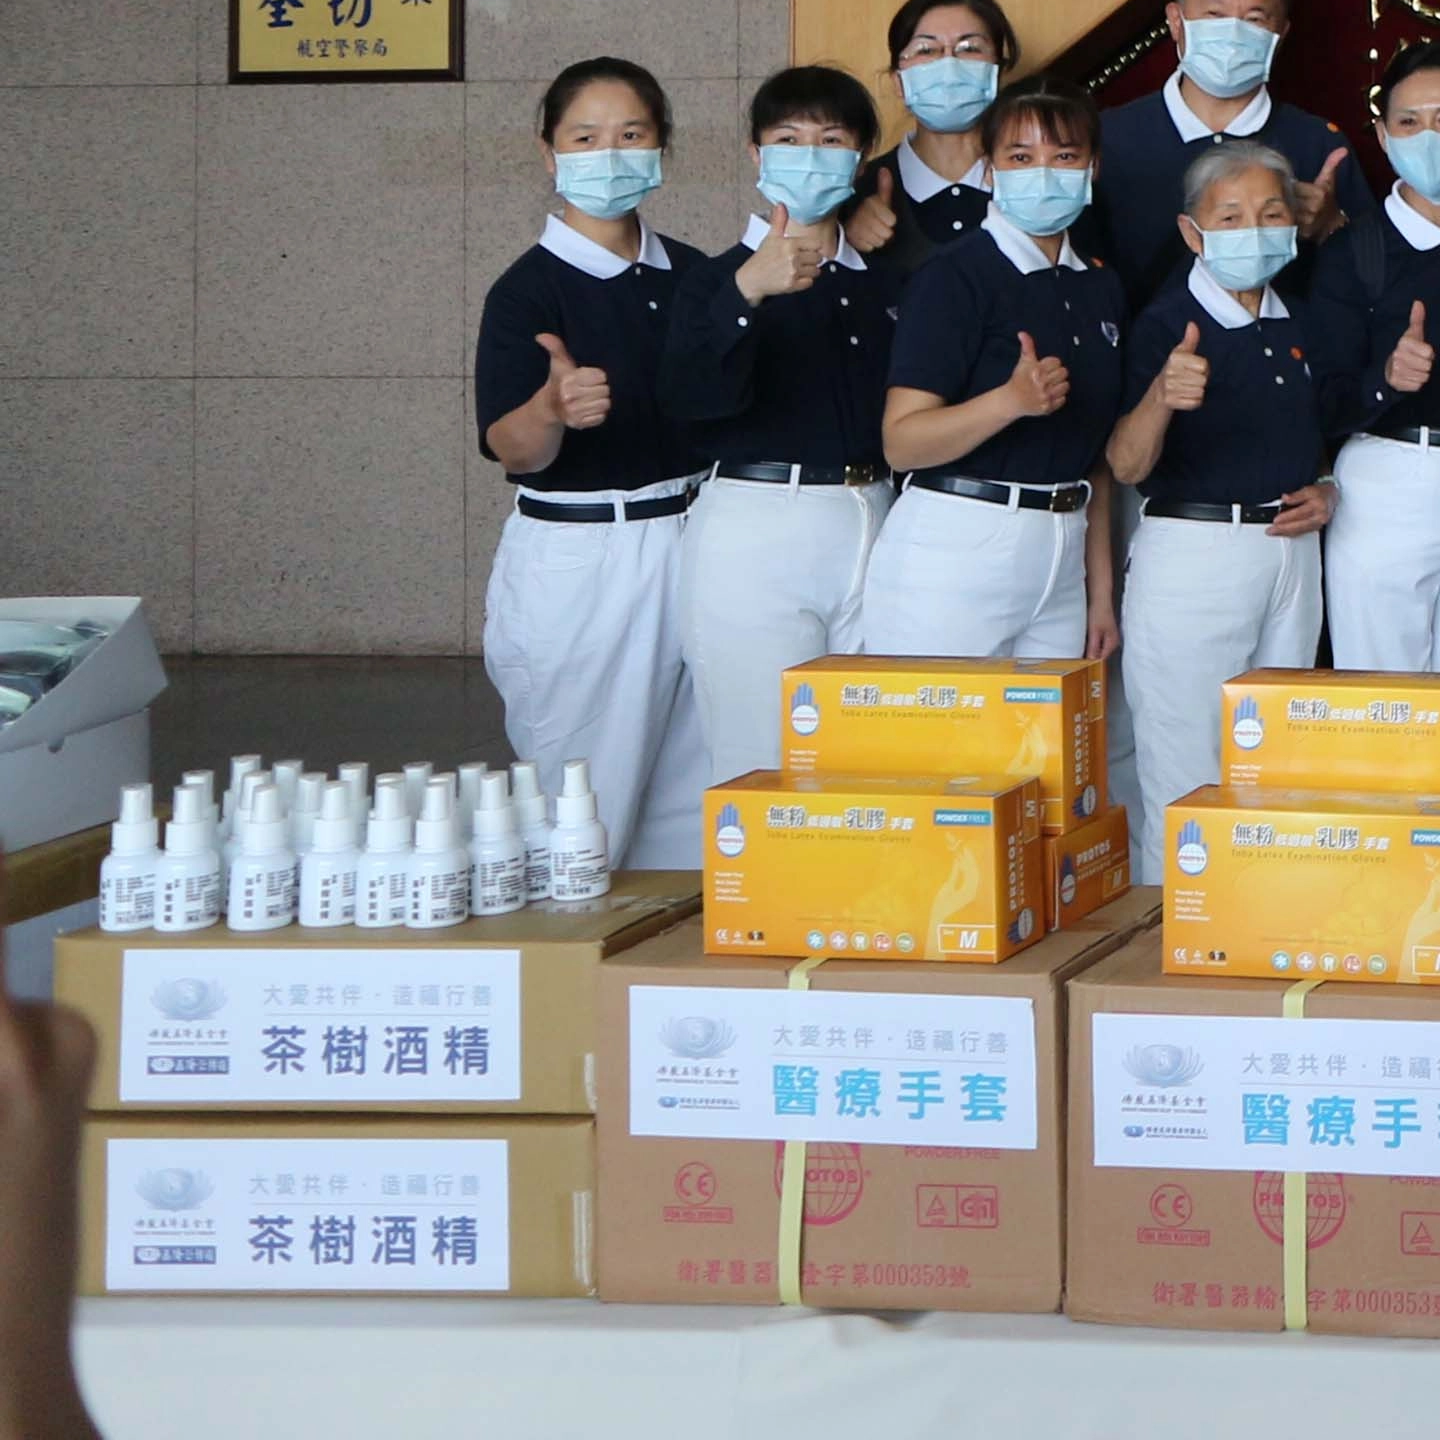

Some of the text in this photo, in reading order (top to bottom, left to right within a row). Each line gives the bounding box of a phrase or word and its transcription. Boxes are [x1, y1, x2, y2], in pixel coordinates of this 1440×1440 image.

[297, 37, 388, 59] 航空警察局
[960, 930, 979, 949] M
[262, 1026, 490, 1075] 茶樹酒精
[772, 1064, 1008, 1123] 醫療手套
[677, 1170, 716, 1198] CE
[1154, 1194, 1189, 1219] CE
[249, 1216, 478, 1265] 茶樹酒精
